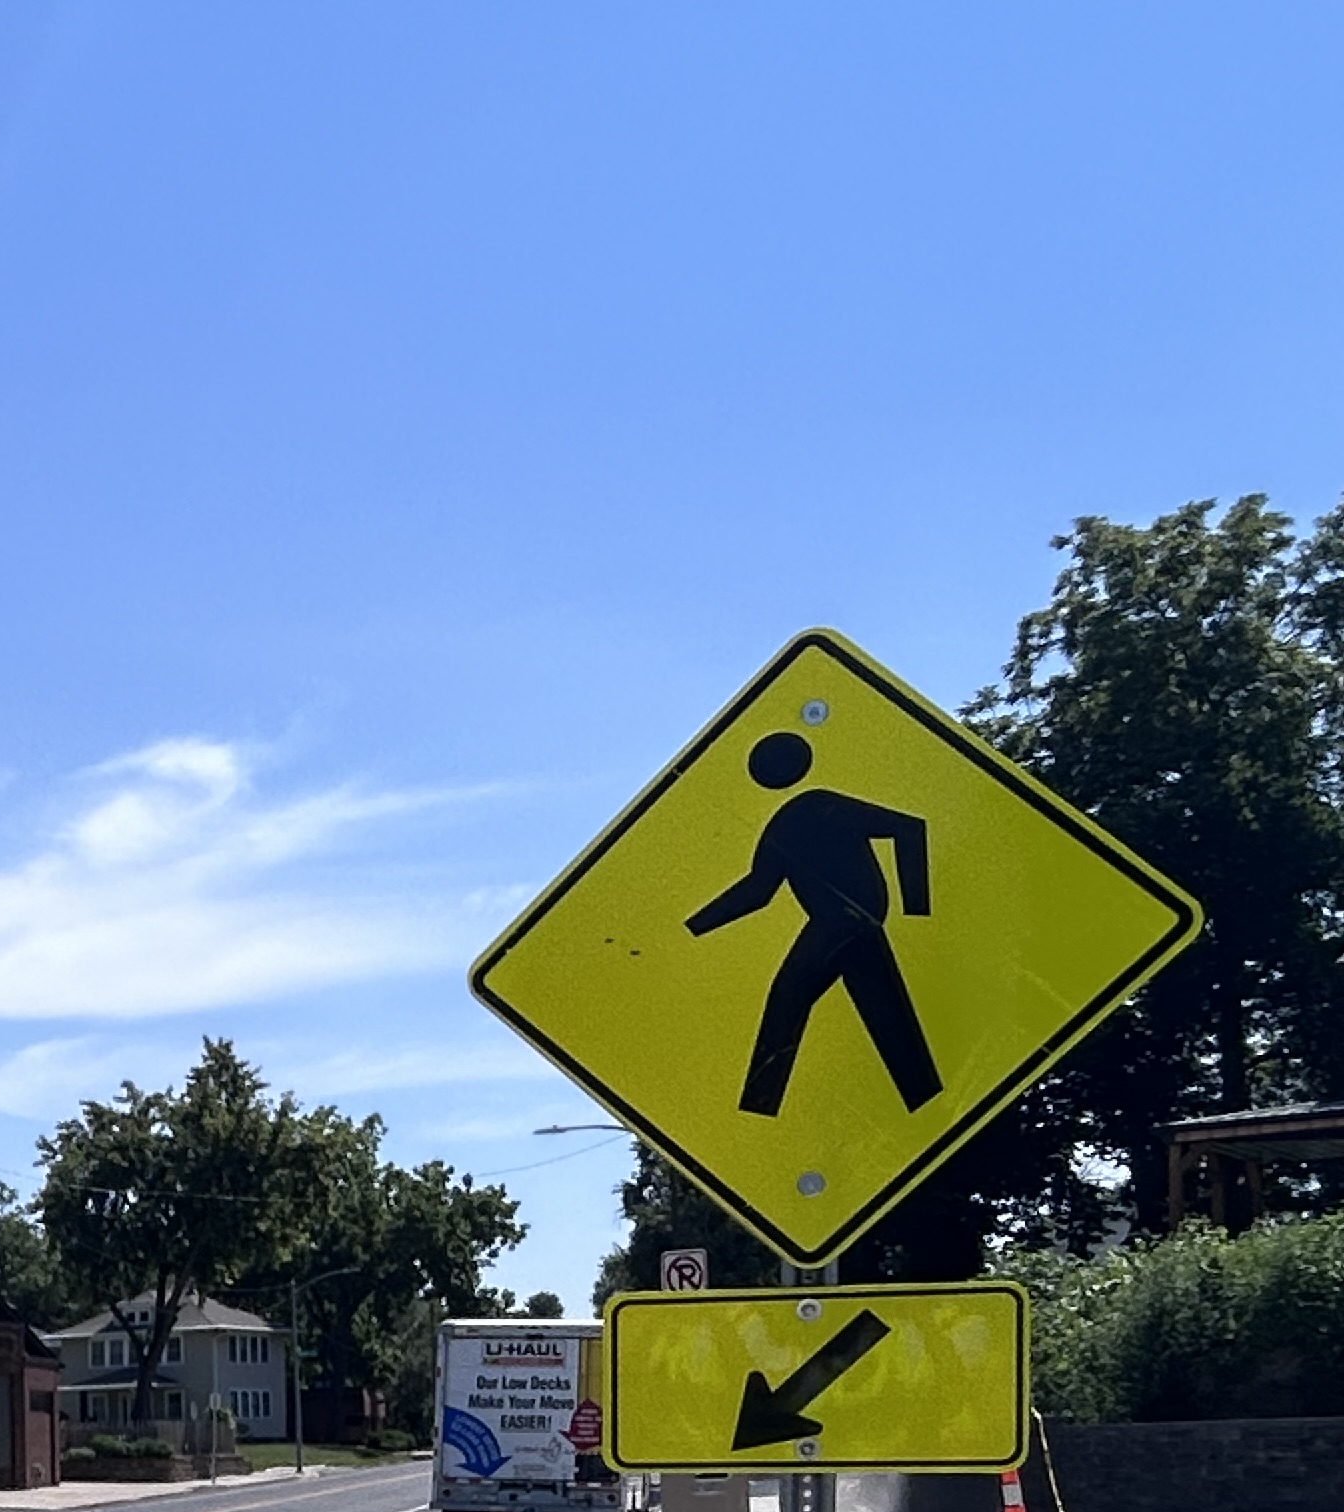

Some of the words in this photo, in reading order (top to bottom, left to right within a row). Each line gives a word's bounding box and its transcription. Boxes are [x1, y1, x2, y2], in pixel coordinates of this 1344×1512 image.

[486, 1343, 562, 1356] U-HAUL
[477, 1375, 498, 1390] Our
[502, 1375, 528, 1390] Low
[531, 1376, 571, 1391] Decks
[468, 1395, 504, 1410] Make
[509, 1395, 535, 1410] Your
[539, 1395, 574, 1410] Move
[501, 1415, 552, 1429] EASIER!
